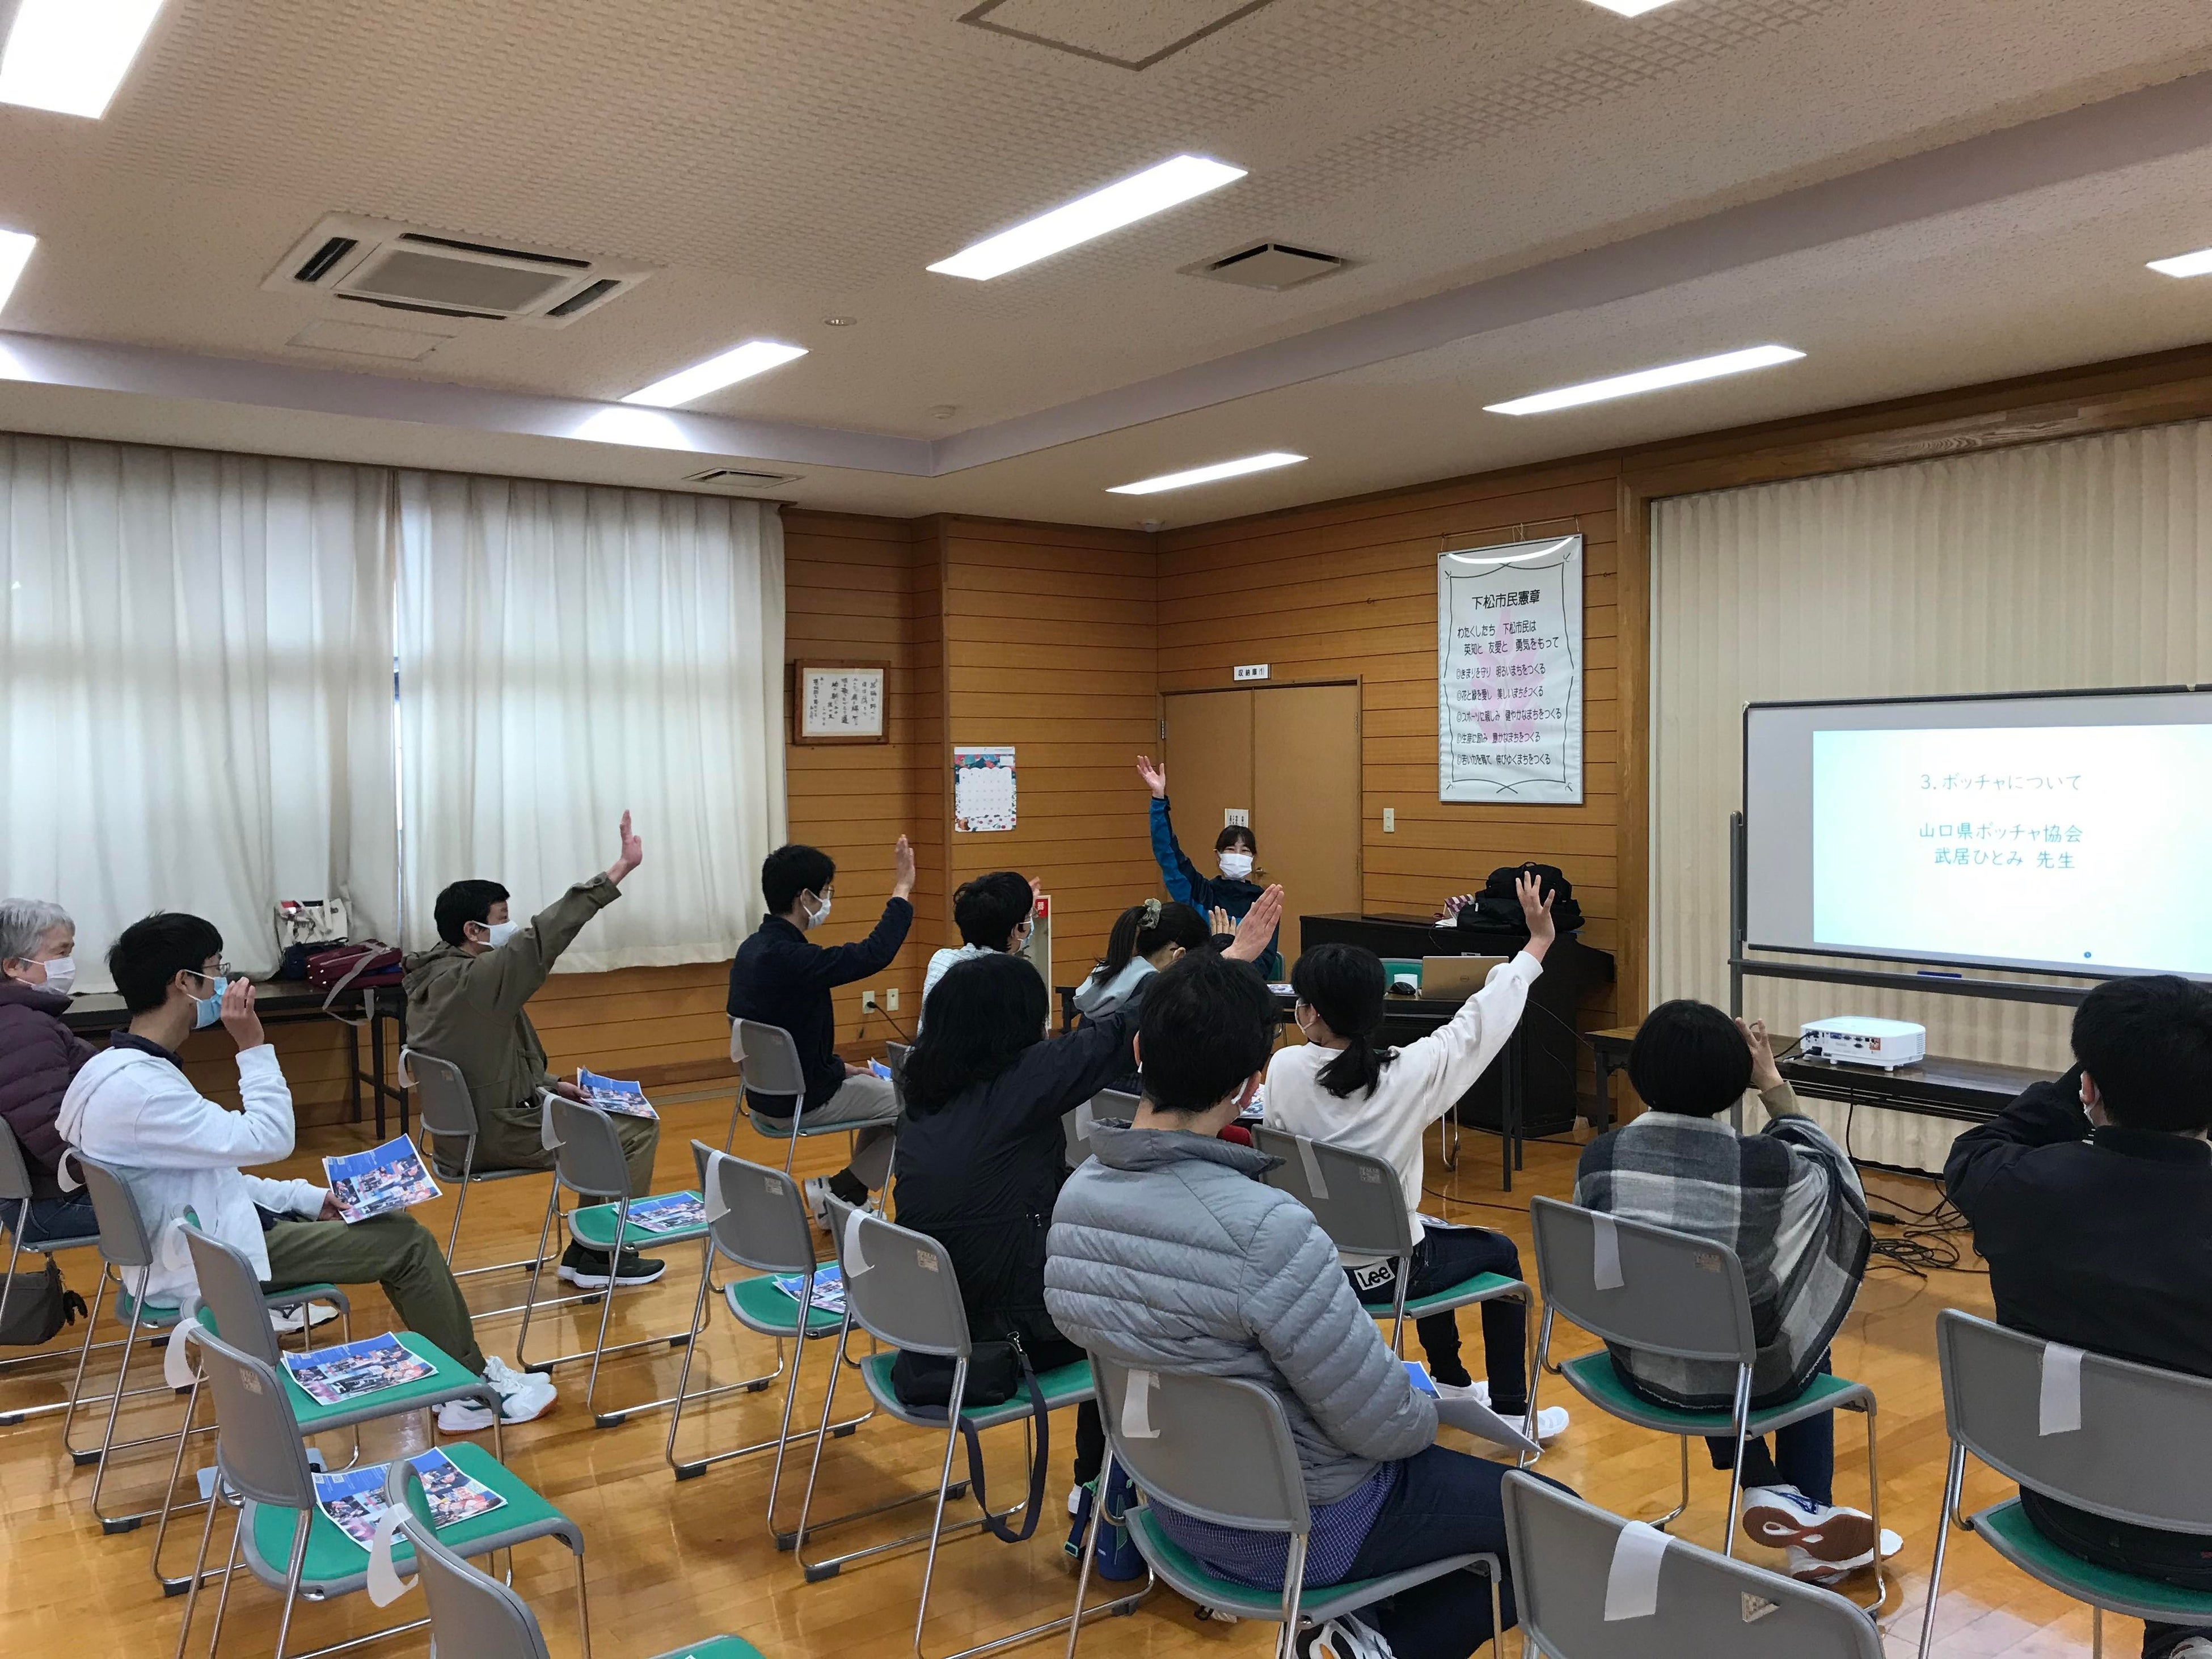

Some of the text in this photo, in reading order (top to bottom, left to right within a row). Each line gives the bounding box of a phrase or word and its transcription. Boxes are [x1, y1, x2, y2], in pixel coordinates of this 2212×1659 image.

[1472, 589, 1540, 610] 下松市民憲章
[1457, 620, 1536, 639] わたくしたち 下松市民は
[1464, 637, 1559, 656] 英知と 友愛と 勇気をもって
[1496, 663, 1546, 677] 明るいまちをつくる
[1497, 686, 1543, 700] 美しいまちをつくる
[1920, 822, 2083, 843] 山口県ボッチャ協会
[1934, 847, 2075, 868] 武居ひとみ 先生
[1357, 1267, 1391, 1287] Lee
